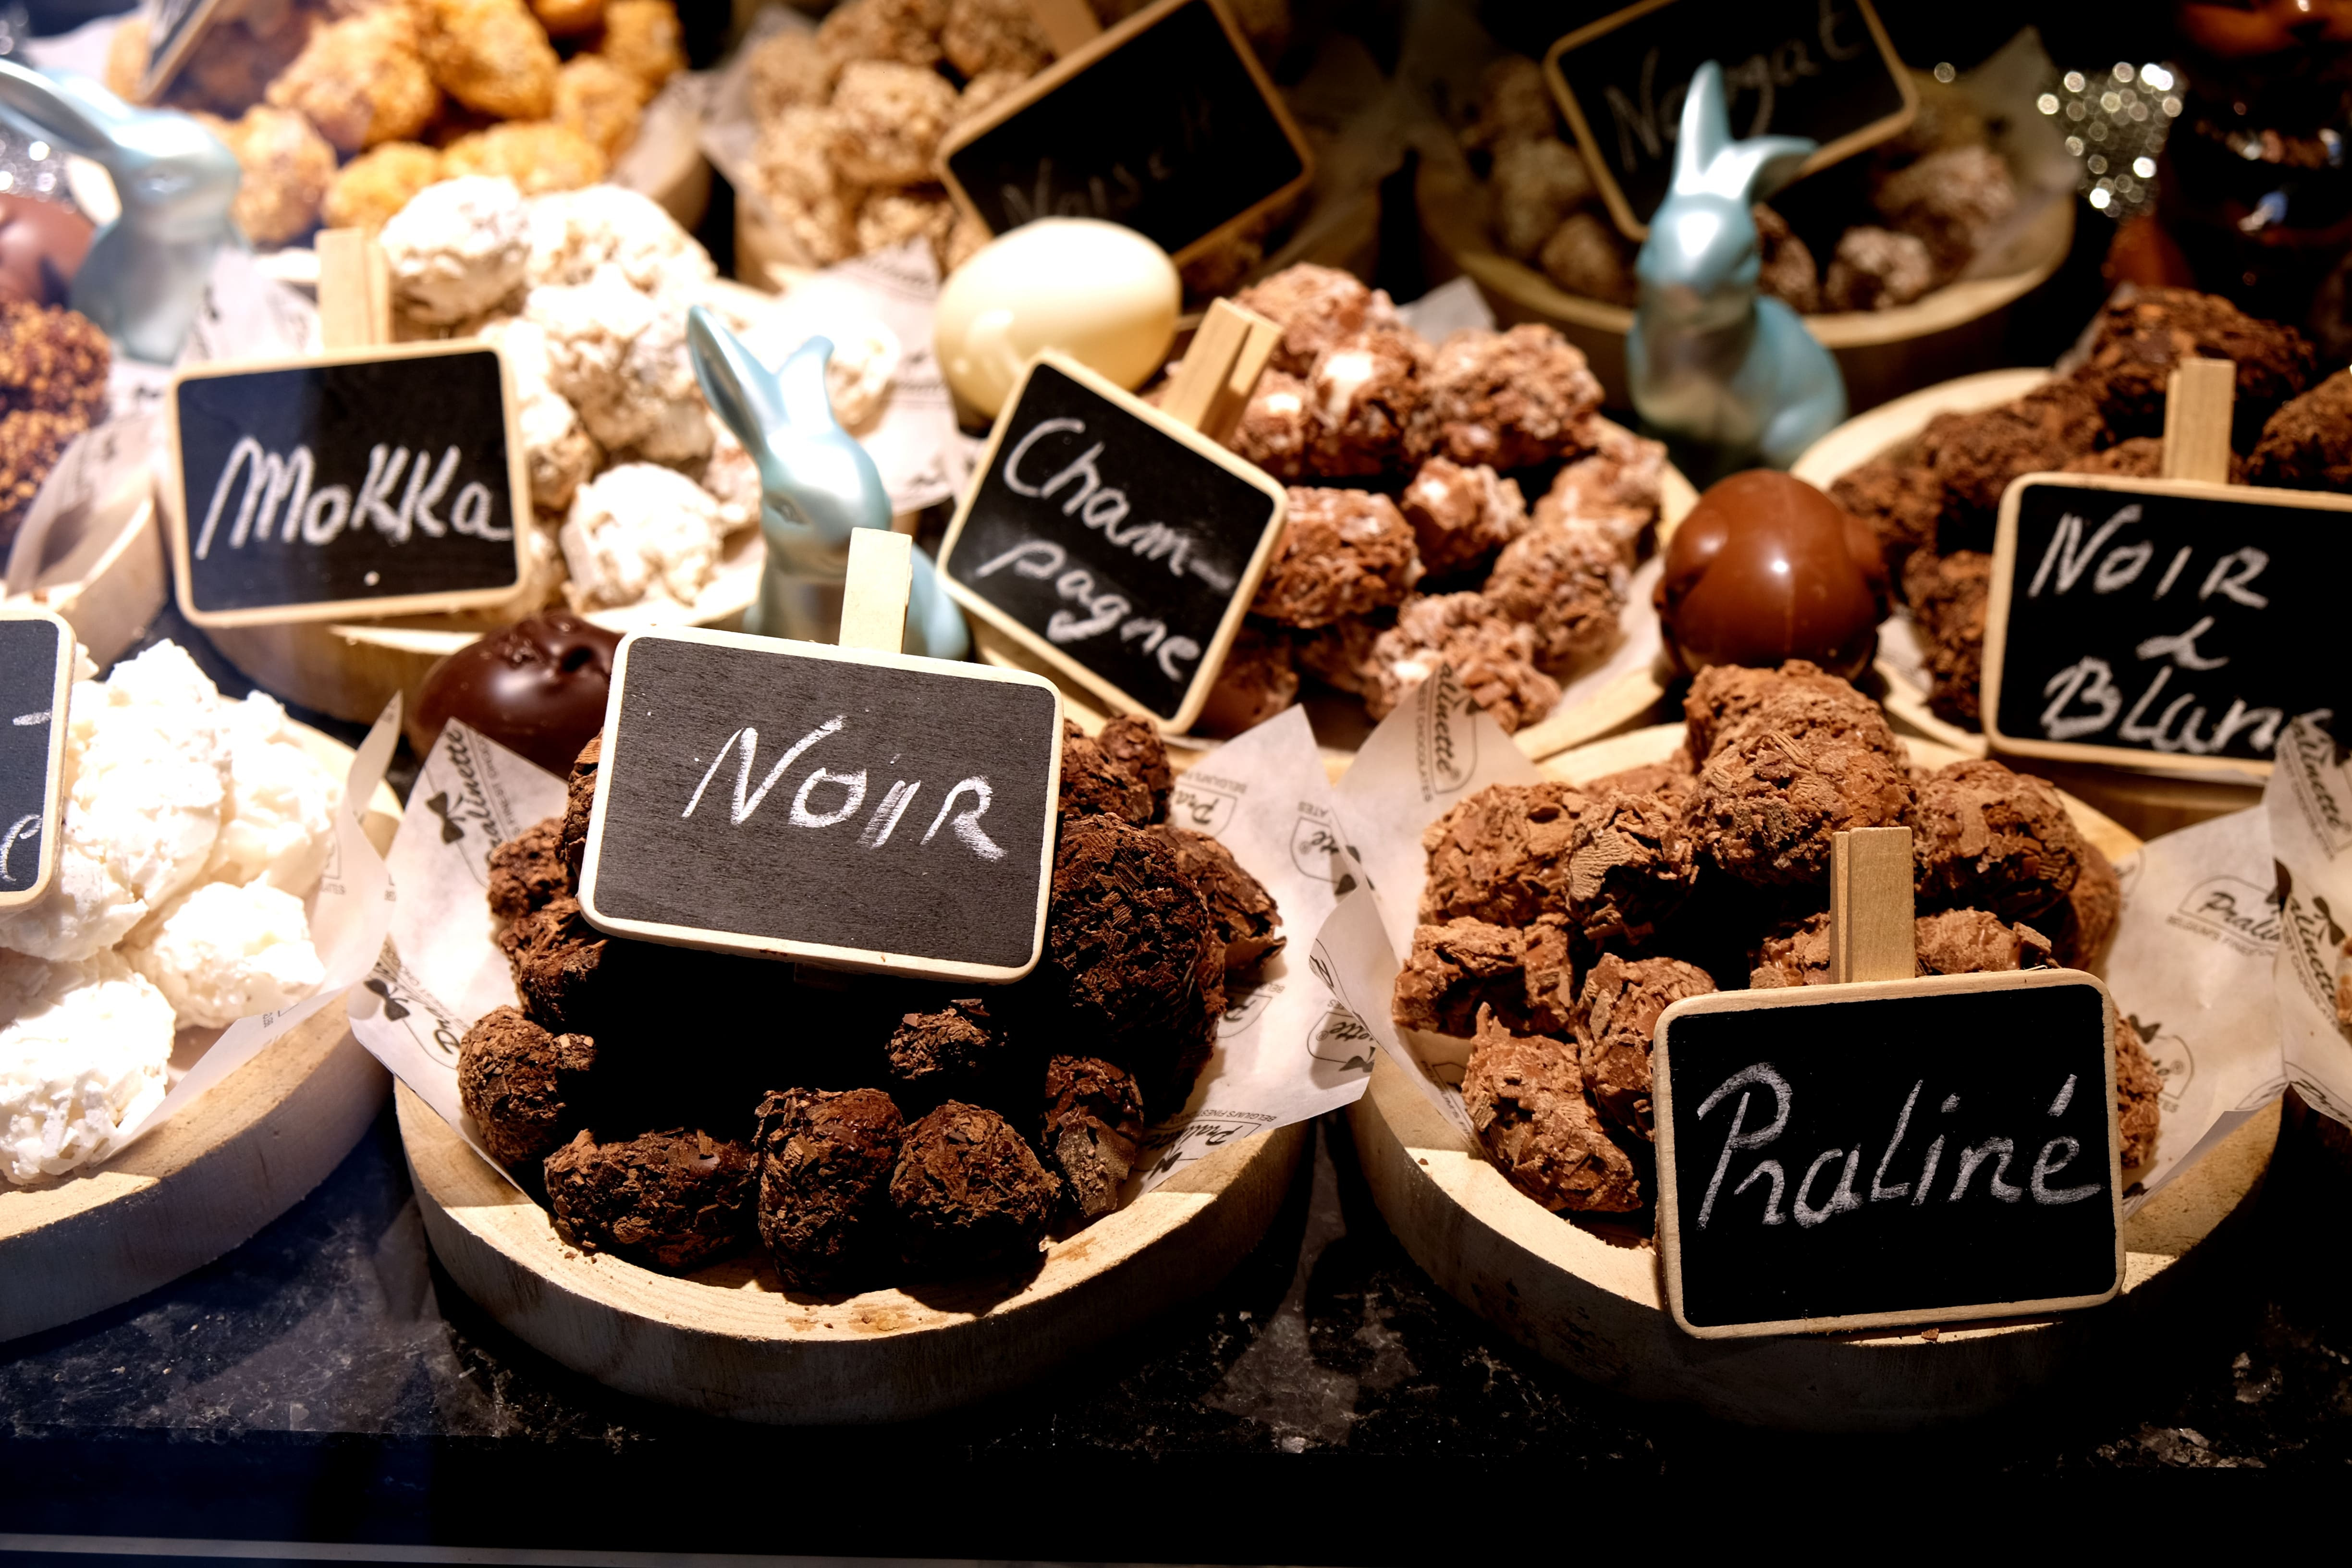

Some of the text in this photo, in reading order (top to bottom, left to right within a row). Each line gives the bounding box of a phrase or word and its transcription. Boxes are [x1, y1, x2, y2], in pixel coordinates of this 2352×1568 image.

[1601, 0, 1870, 175] Nogat
[1003, 417, 1235, 591] Cham-
[445, 726, 502, 862] ralinette
[1433, 663, 1459, 774] alinette
